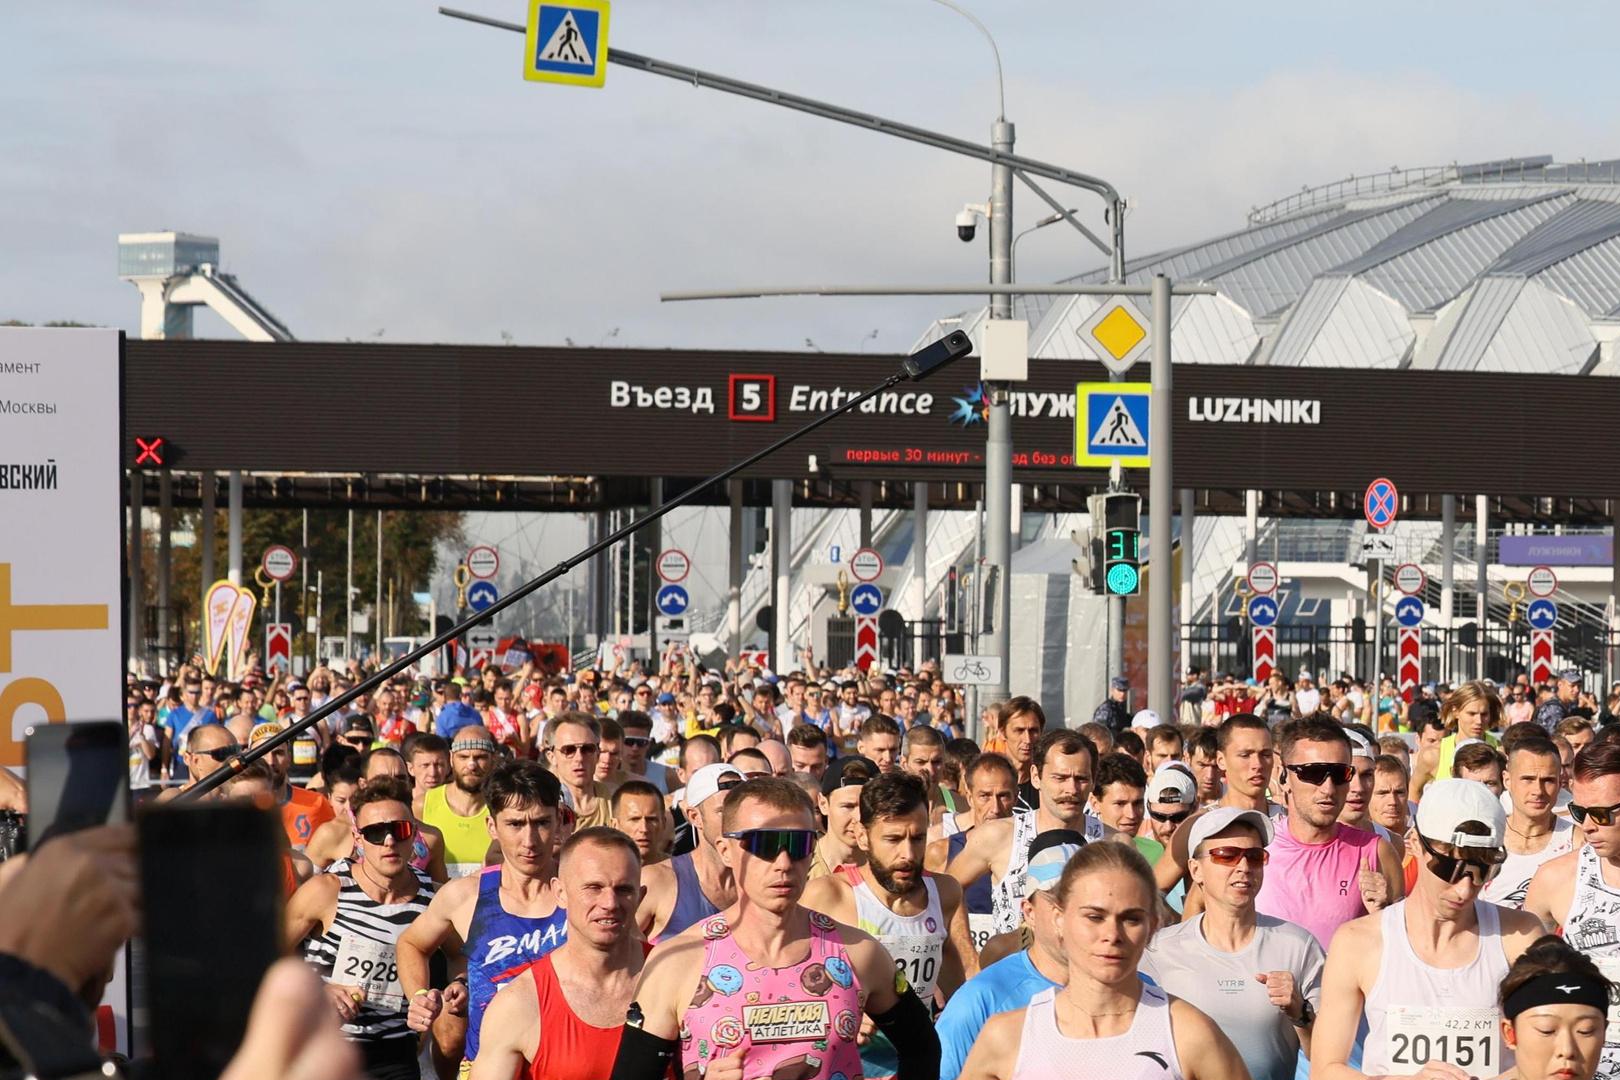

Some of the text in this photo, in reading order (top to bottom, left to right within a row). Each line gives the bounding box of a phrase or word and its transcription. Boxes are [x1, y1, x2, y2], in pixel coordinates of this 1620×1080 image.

[610, 381, 714, 413] Въезд
[741, 384, 761, 411] 5
[789, 385, 933, 414] Entrance
[1189, 397, 1321, 424] LUZHNIKI
[847, 449, 900, 464] первые
[905, 449, 922, 461] 30
[927, 451, 970, 465] минут
[1032, 451, 1057, 464] без
[749, 1003, 824, 1027] НЕЛЕГКАЯ
[1445, 1020, 1470, 1030] 42,2
[755, 1024, 822, 1037] АТЛЕТИКА
[1391, 1033, 1491, 1067] 20151
